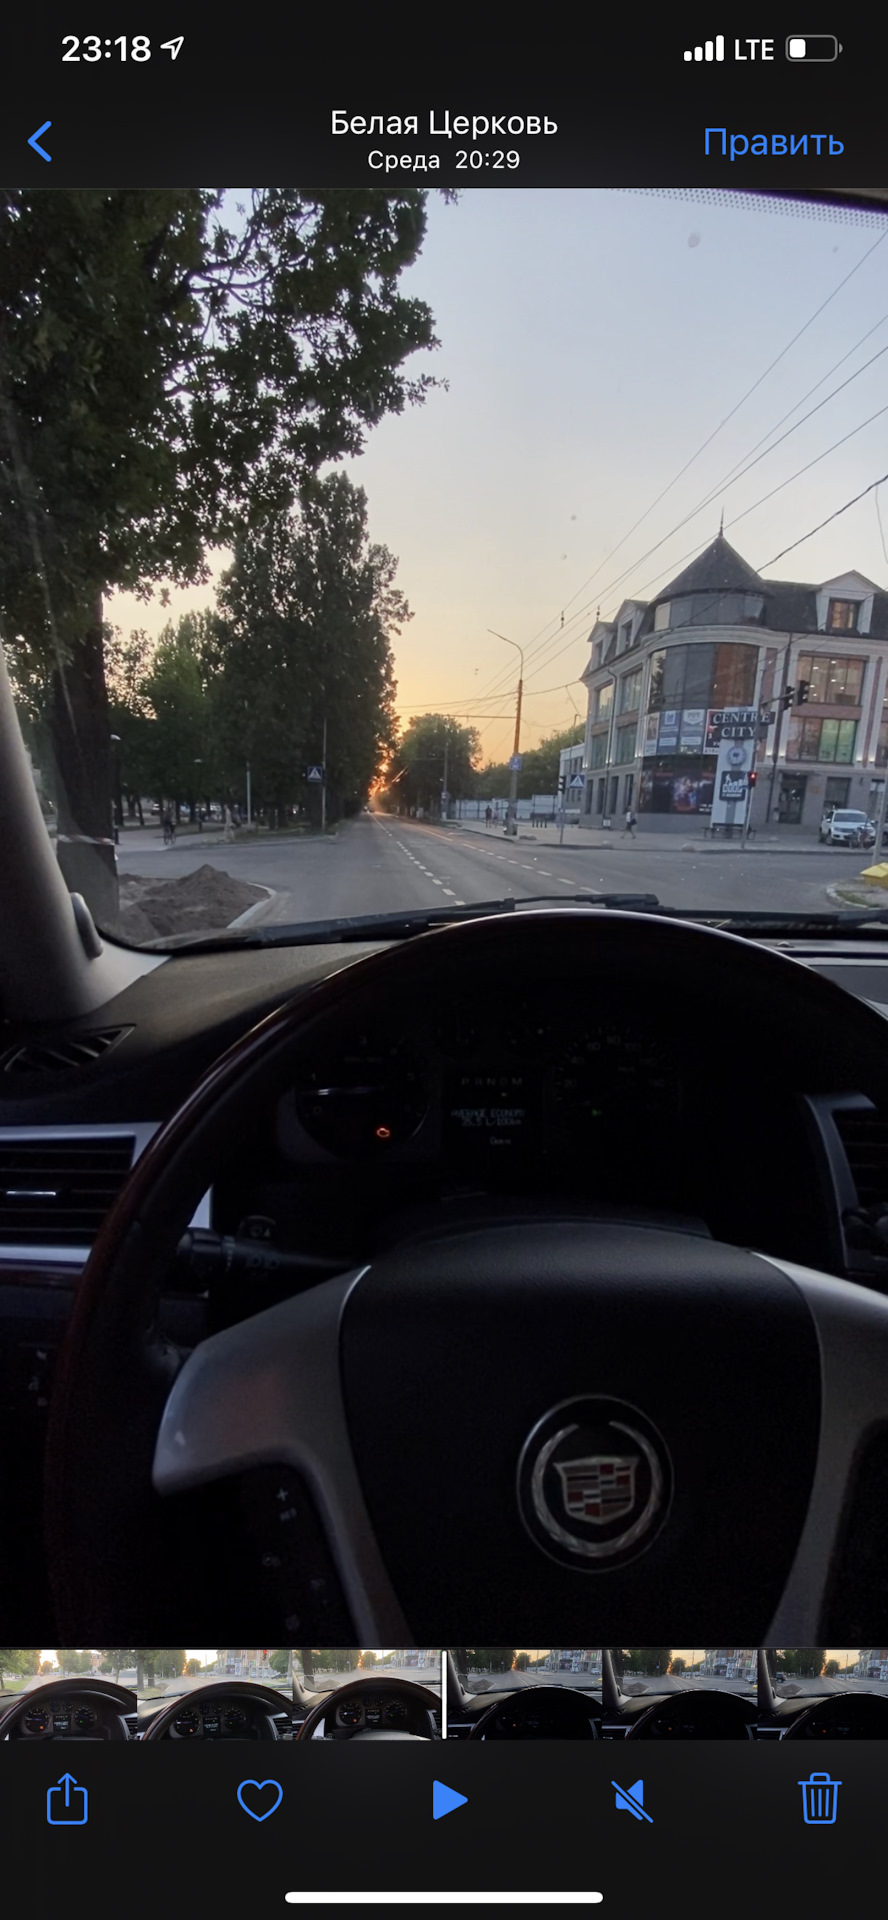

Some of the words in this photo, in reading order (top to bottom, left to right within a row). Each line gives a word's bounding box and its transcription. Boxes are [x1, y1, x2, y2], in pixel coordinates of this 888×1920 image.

[61, 35, 152, 63] 23:18
[734, 38, 775, 61] LTE
[331, 109, 418, 135] Белая
[429, 109, 558, 141] Церковь
[704, 127, 845, 162] Править
[367, 149, 440, 173] Среда
[455, 149, 520, 170] 20:29
[712, 711, 771, 725] CENTRE
[721, 726, 757, 738] CITY
